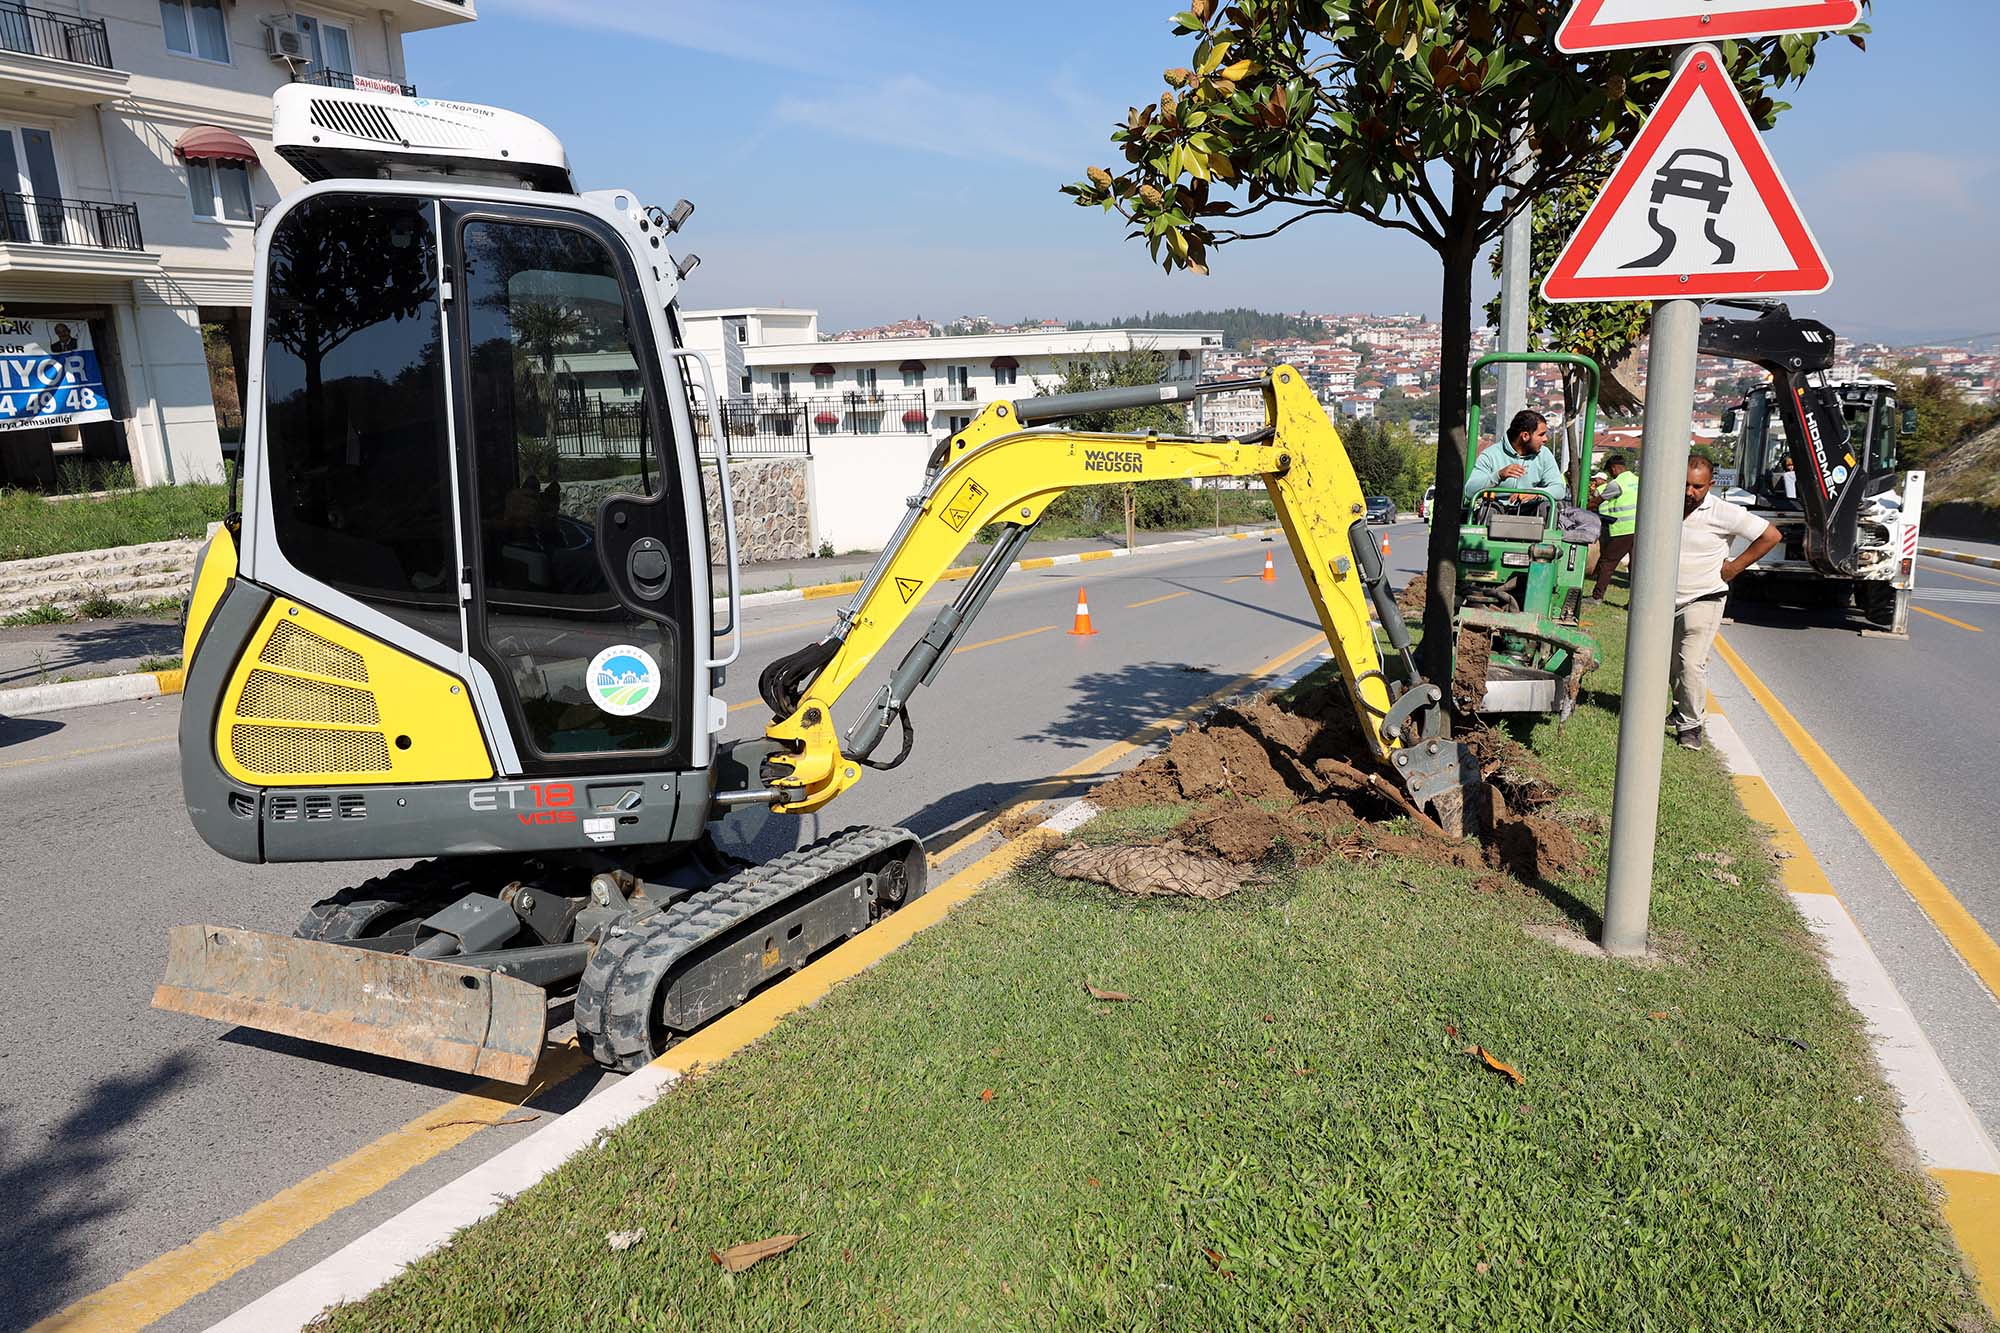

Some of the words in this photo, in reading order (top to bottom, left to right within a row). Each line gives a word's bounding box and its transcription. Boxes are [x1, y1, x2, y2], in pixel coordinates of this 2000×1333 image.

[434, 101, 495, 118] TECNOPOINT
[0, 356, 88, 388] IYOR
[26, 392, 57, 414] 49
[66, 387, 98, 410] 48
[1085, 450, 1142, 463] WACKER
[1085, 461, 1142, 473] NEUSON
